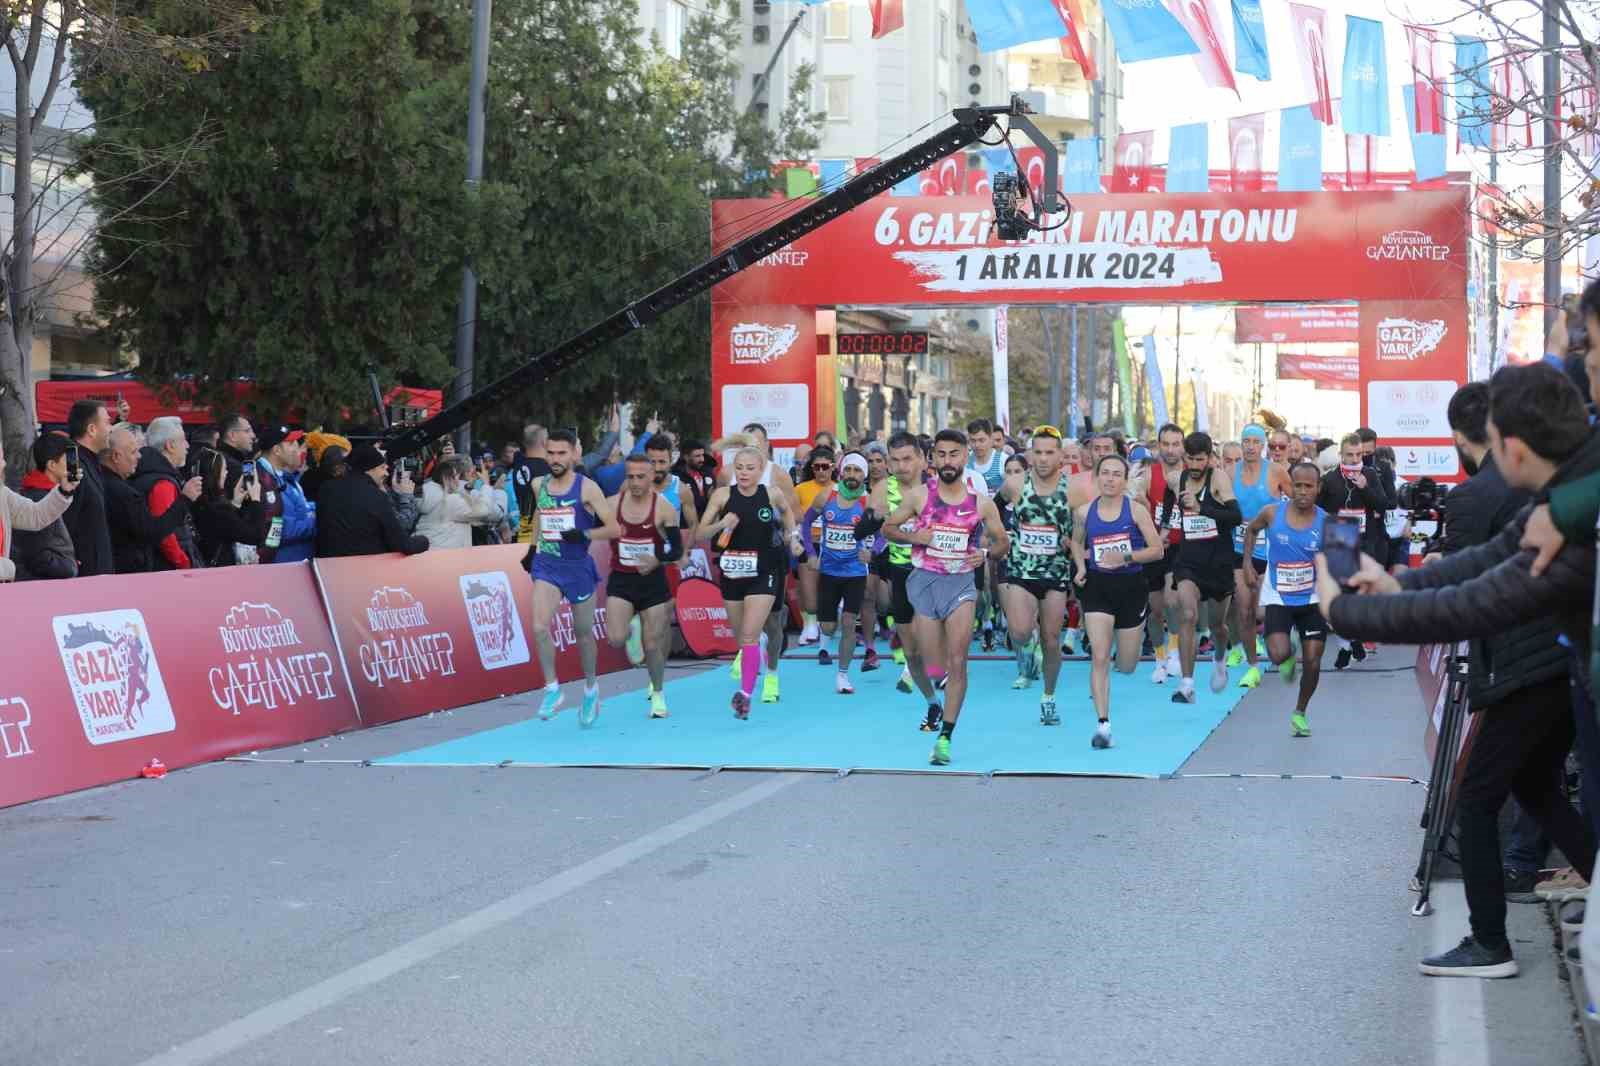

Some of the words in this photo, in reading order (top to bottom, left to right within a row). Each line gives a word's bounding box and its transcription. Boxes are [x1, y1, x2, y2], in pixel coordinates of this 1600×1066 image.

[1005, 210, 1083, 244] ARI
[1094, 208, 1298, 243] MARATONU
[955, 255, 968, 281] 1
[978, 253, 1098, 281] ARALIK
[1104, 252, 1175, 280] 2024
[1023, 534, 1053, 546] 2255
[724, 559, 753, 570] 2399
[208, 652, 337, 716] GAZİANTEP
[83, 688, 123, 719] YARI
